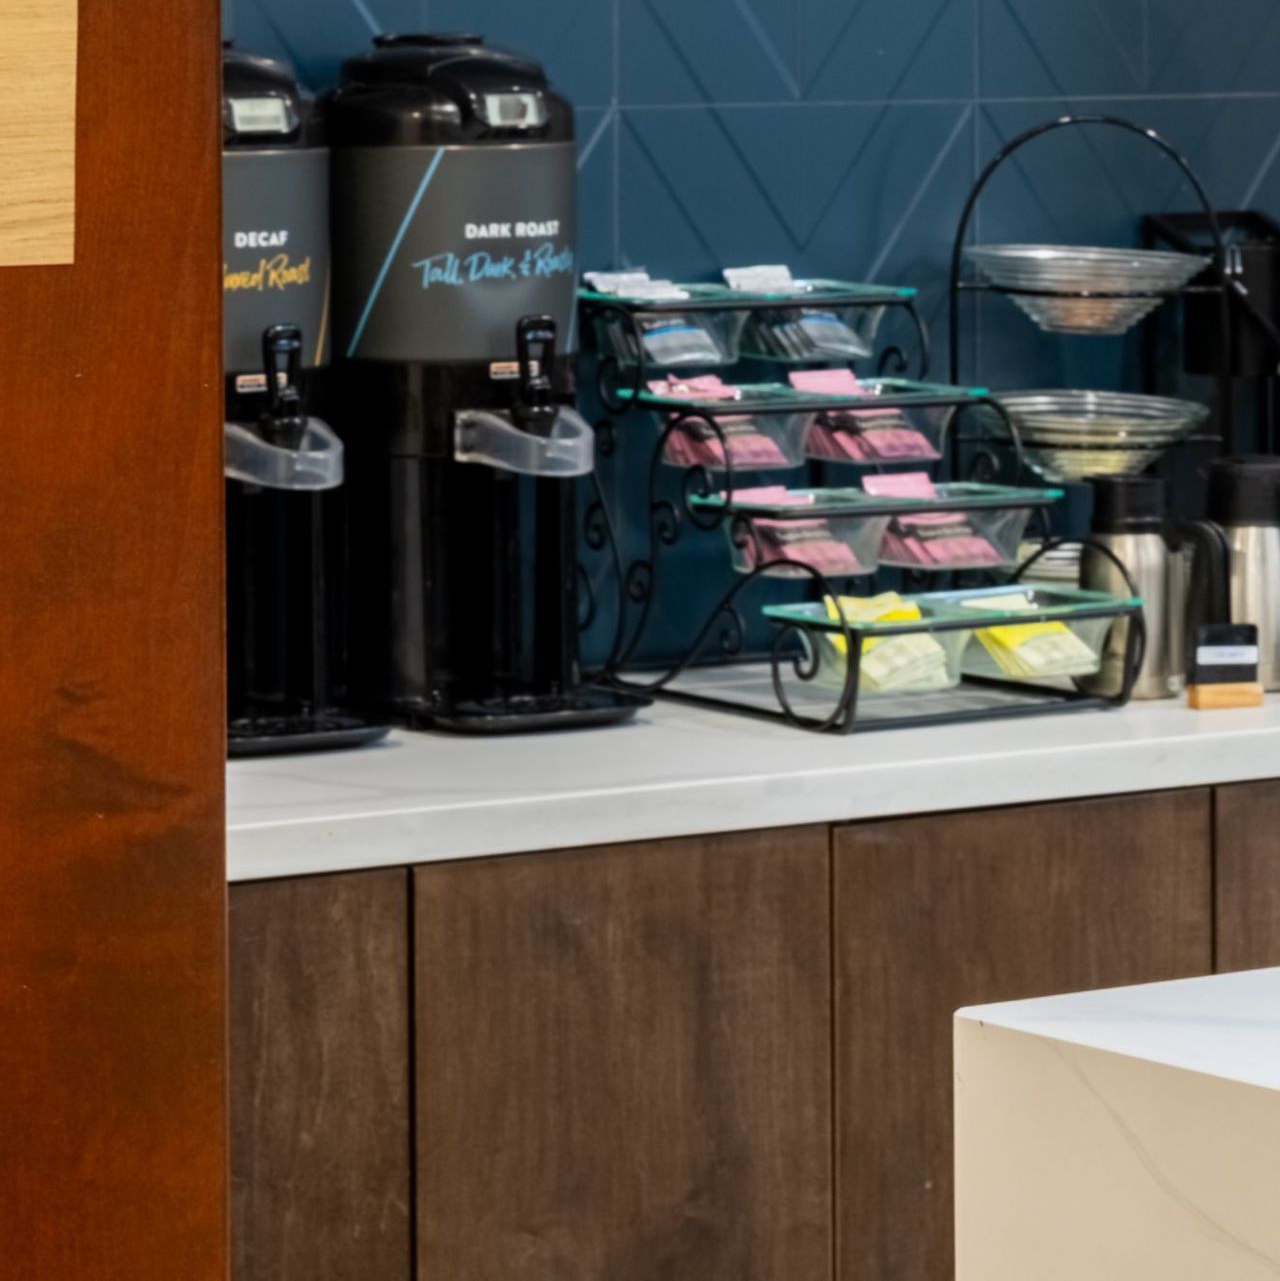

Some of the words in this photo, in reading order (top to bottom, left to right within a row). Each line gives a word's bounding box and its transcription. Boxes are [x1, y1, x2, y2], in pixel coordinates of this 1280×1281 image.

[234, 230, 290, 248] DECAF
[464, 222, 511, 241] DARK
[515, 220, 560, 239] ROAST
